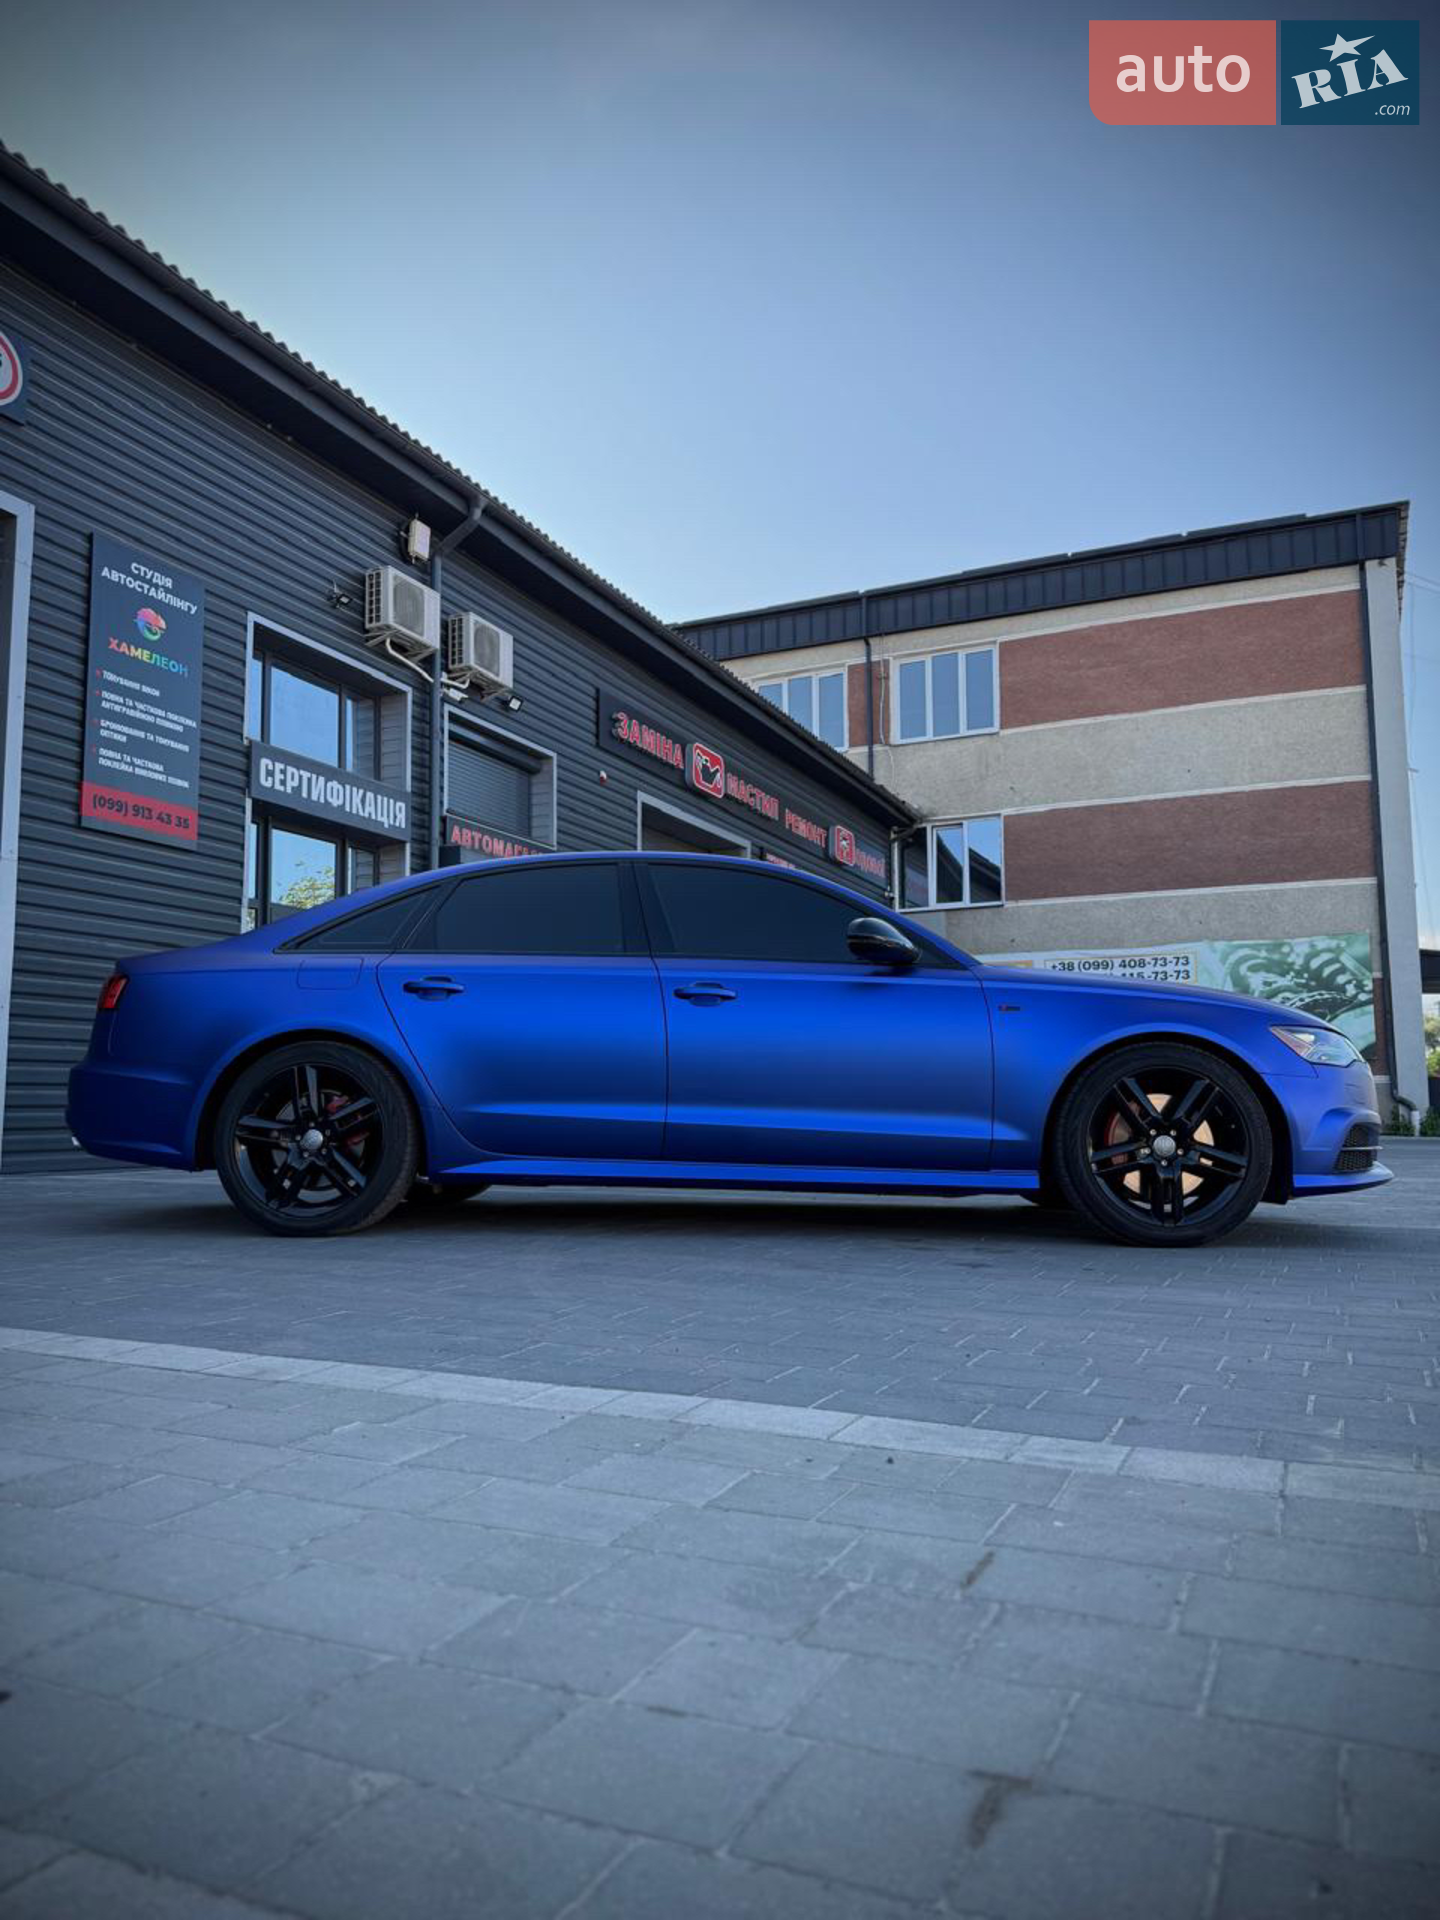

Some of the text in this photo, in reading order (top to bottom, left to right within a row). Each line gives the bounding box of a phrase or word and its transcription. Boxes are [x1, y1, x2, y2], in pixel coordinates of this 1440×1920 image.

[101, 566, 198, 615] АВТОСТАЙЛІНГУ
[131, 562, 173, 589] СТУДІЯ
[108, 637, 189, 678] ХАМЕЛЕОН
[612, 710, 684, 769] ЗАМІНА
[93, 793, 128, 817] (099)
[131, 804, 153, 820] 913
[259, 757, 406, 829] СЕРТИФІКАЦІЯ
[1051, 955, 1191, 972] +38 (099) 408-73-73
